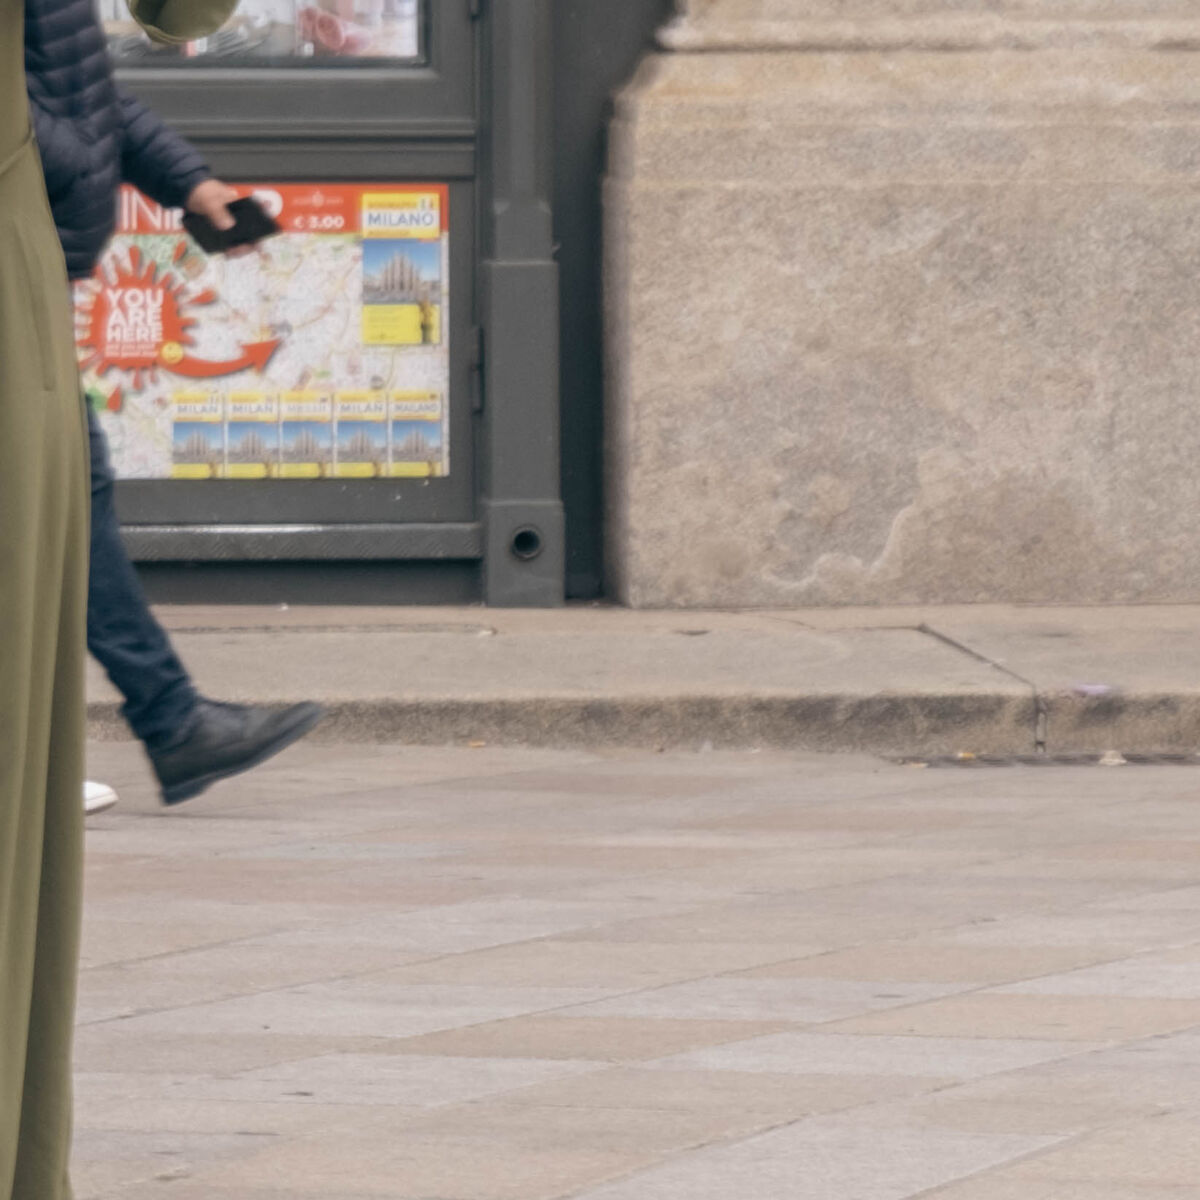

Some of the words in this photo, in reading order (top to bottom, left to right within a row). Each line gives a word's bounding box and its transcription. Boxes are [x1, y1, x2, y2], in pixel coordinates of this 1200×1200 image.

[367, 211, 434, 227] MILANO
[106, 288, 164, 308] YOU
[107, 308, 163, 326] ARE
[106, 326, 163, 343] HERE
